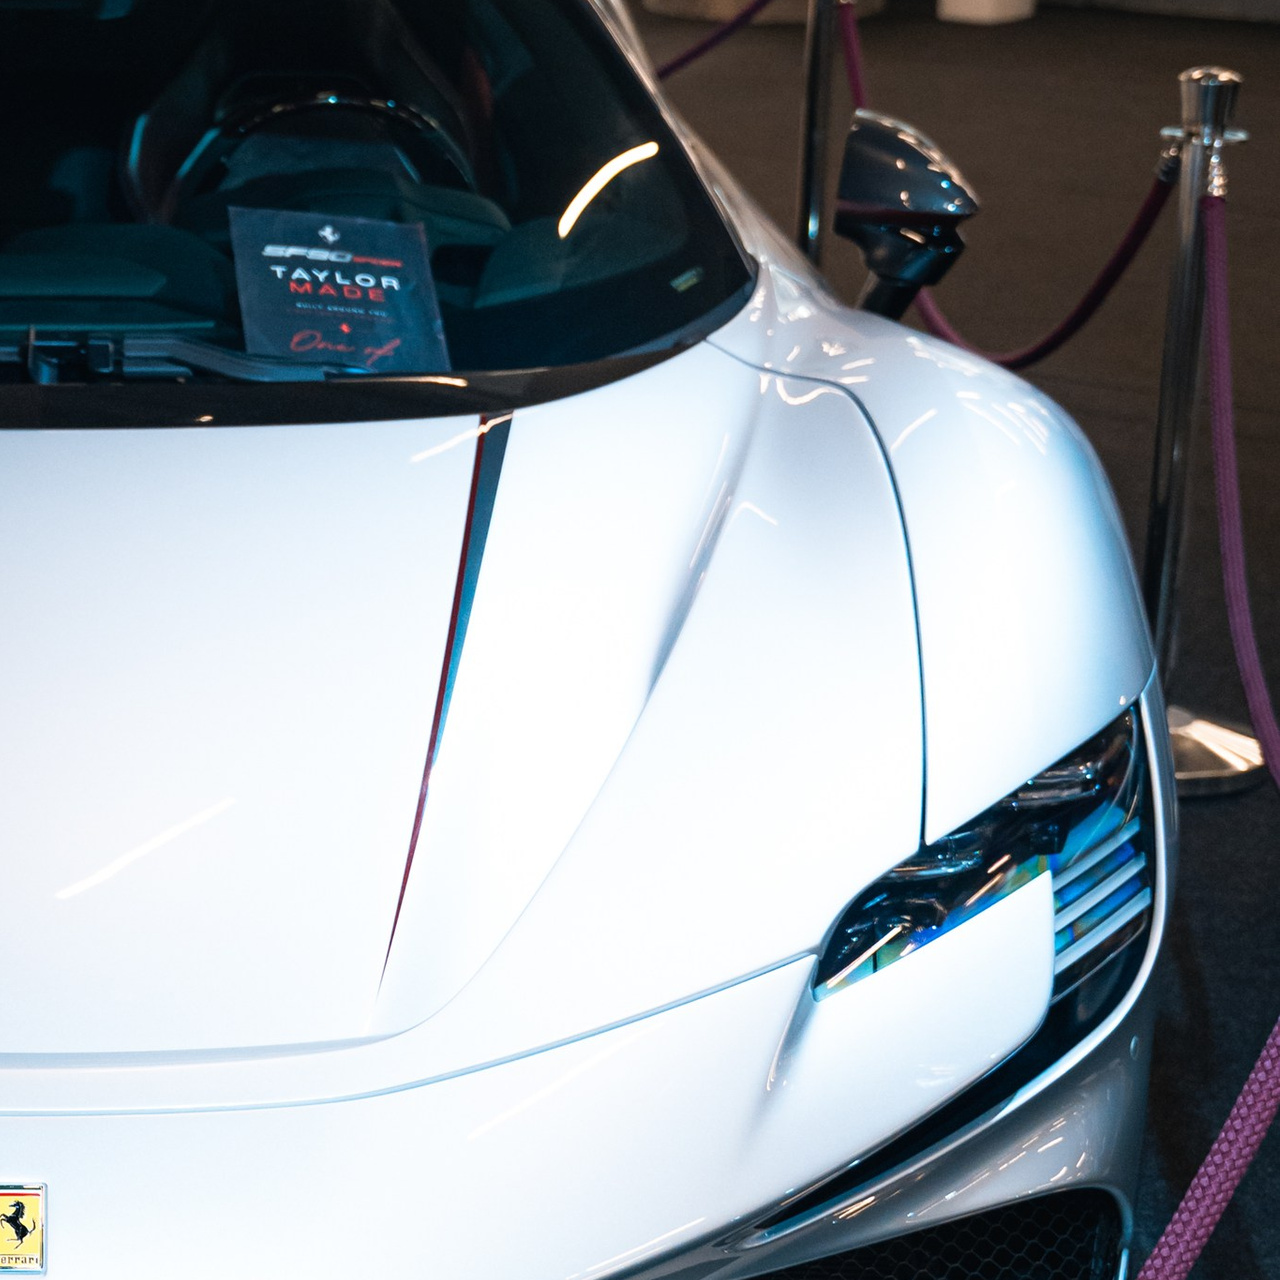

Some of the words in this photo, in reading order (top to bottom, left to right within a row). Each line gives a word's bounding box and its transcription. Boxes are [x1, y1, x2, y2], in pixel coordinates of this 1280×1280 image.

[270, 265, 401, 291] TAYLOR
[289, 281, 385, 302] MADE
[290, 329, 355, 352] One
